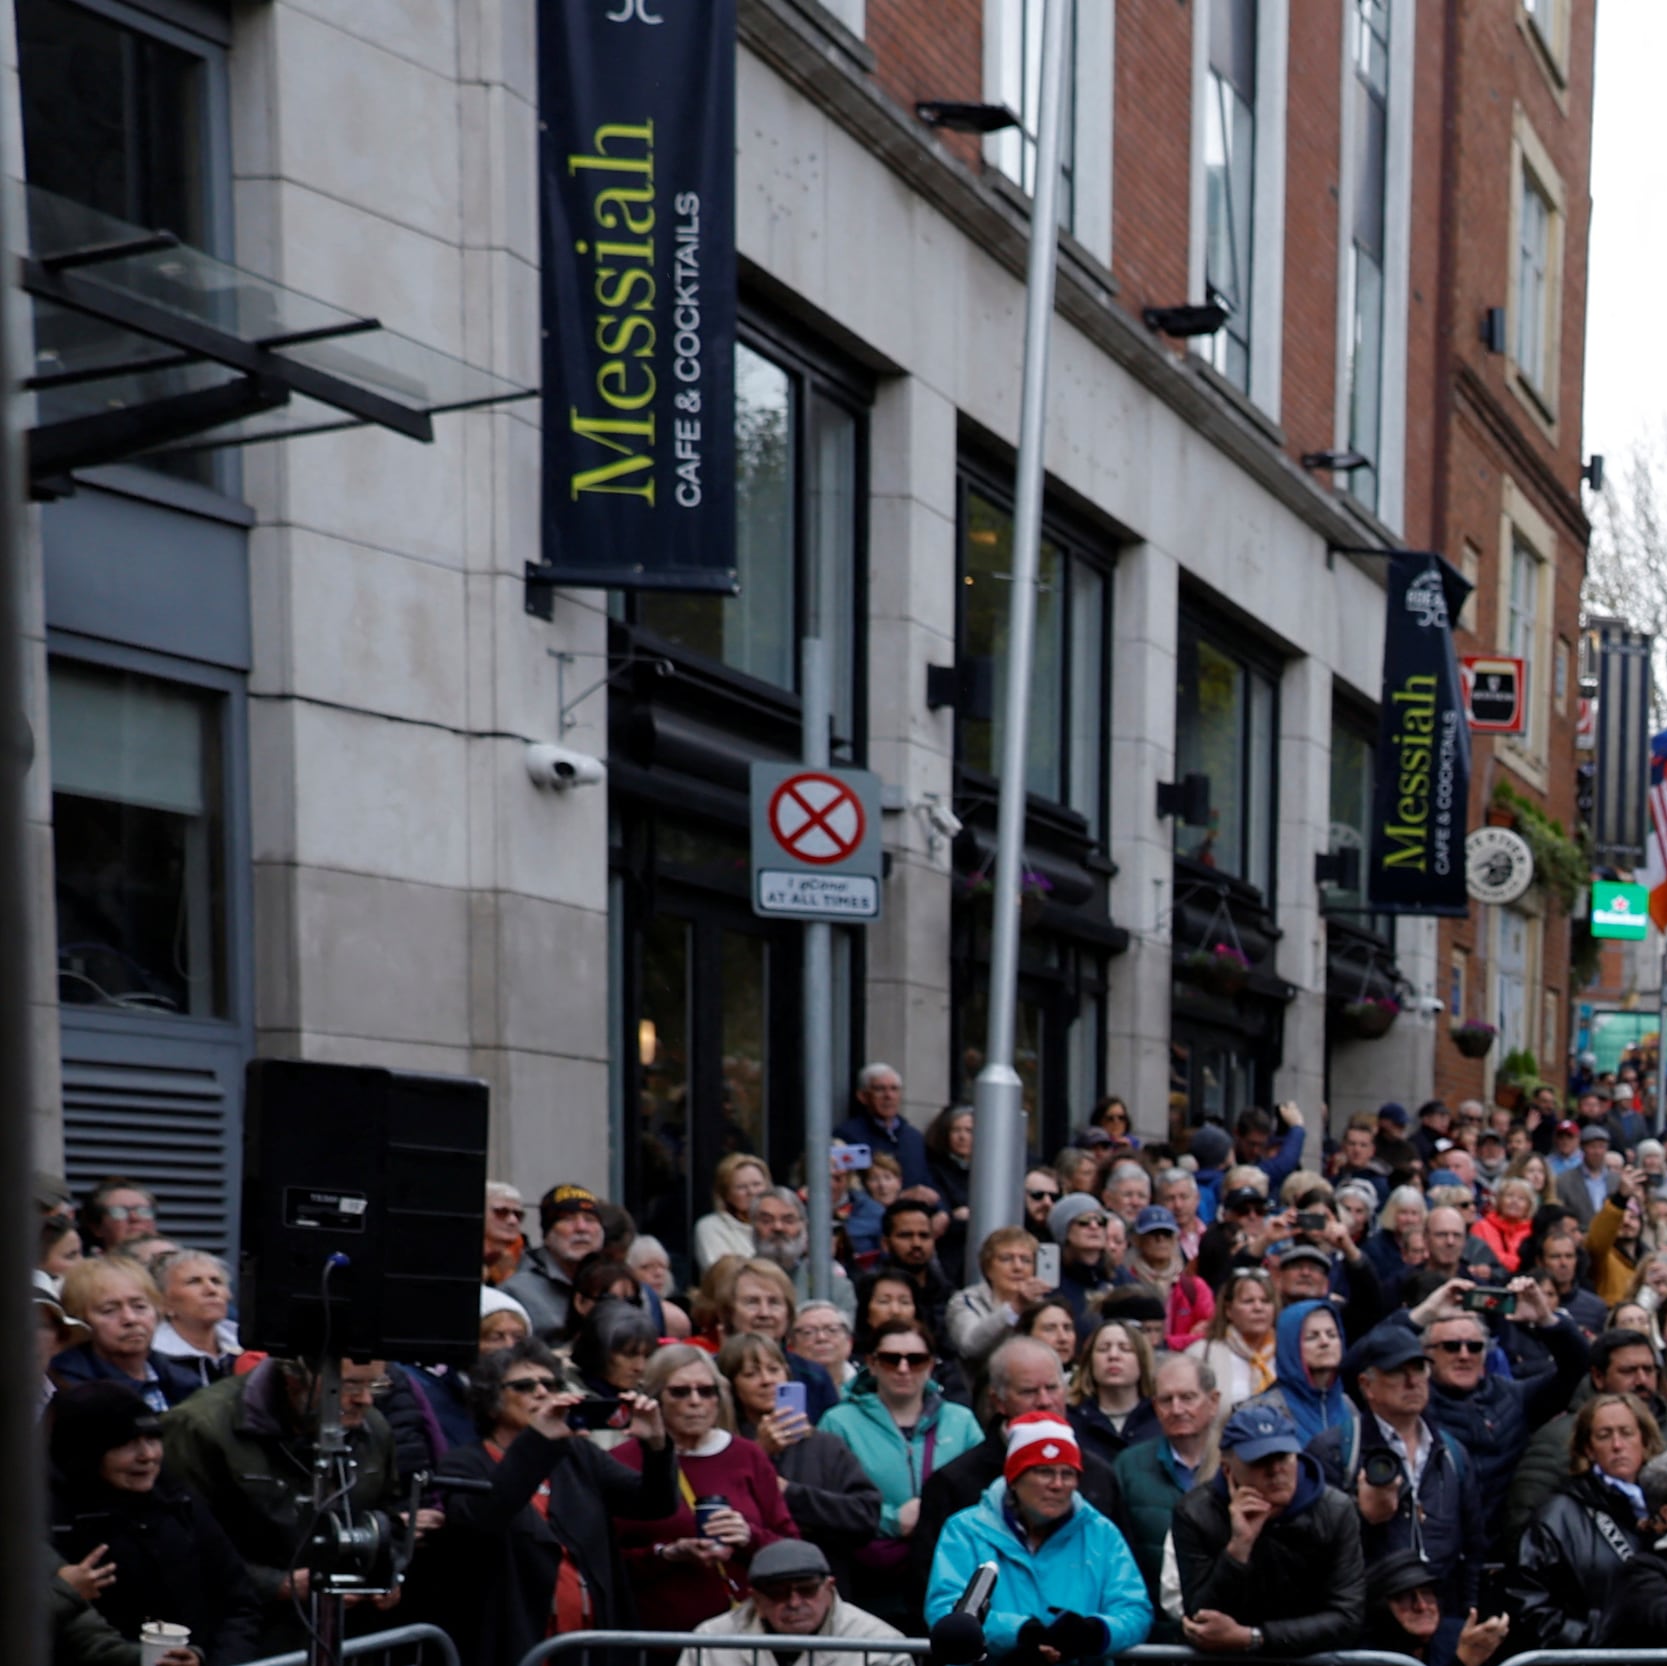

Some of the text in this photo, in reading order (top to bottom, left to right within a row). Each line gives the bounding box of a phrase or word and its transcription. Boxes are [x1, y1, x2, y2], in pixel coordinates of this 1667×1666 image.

[569, 118, 656, 508] Messiah
[673, 190, 702, 509] CAFE & COCKTAILS
[1384, 675, 1438, 873] Messiah
[1436, 709, 1457, 809] COCKTAILS
[768, 891, 870, 909] AT ALL TIMES
[1435, 827, 1451, 875] CAFE
